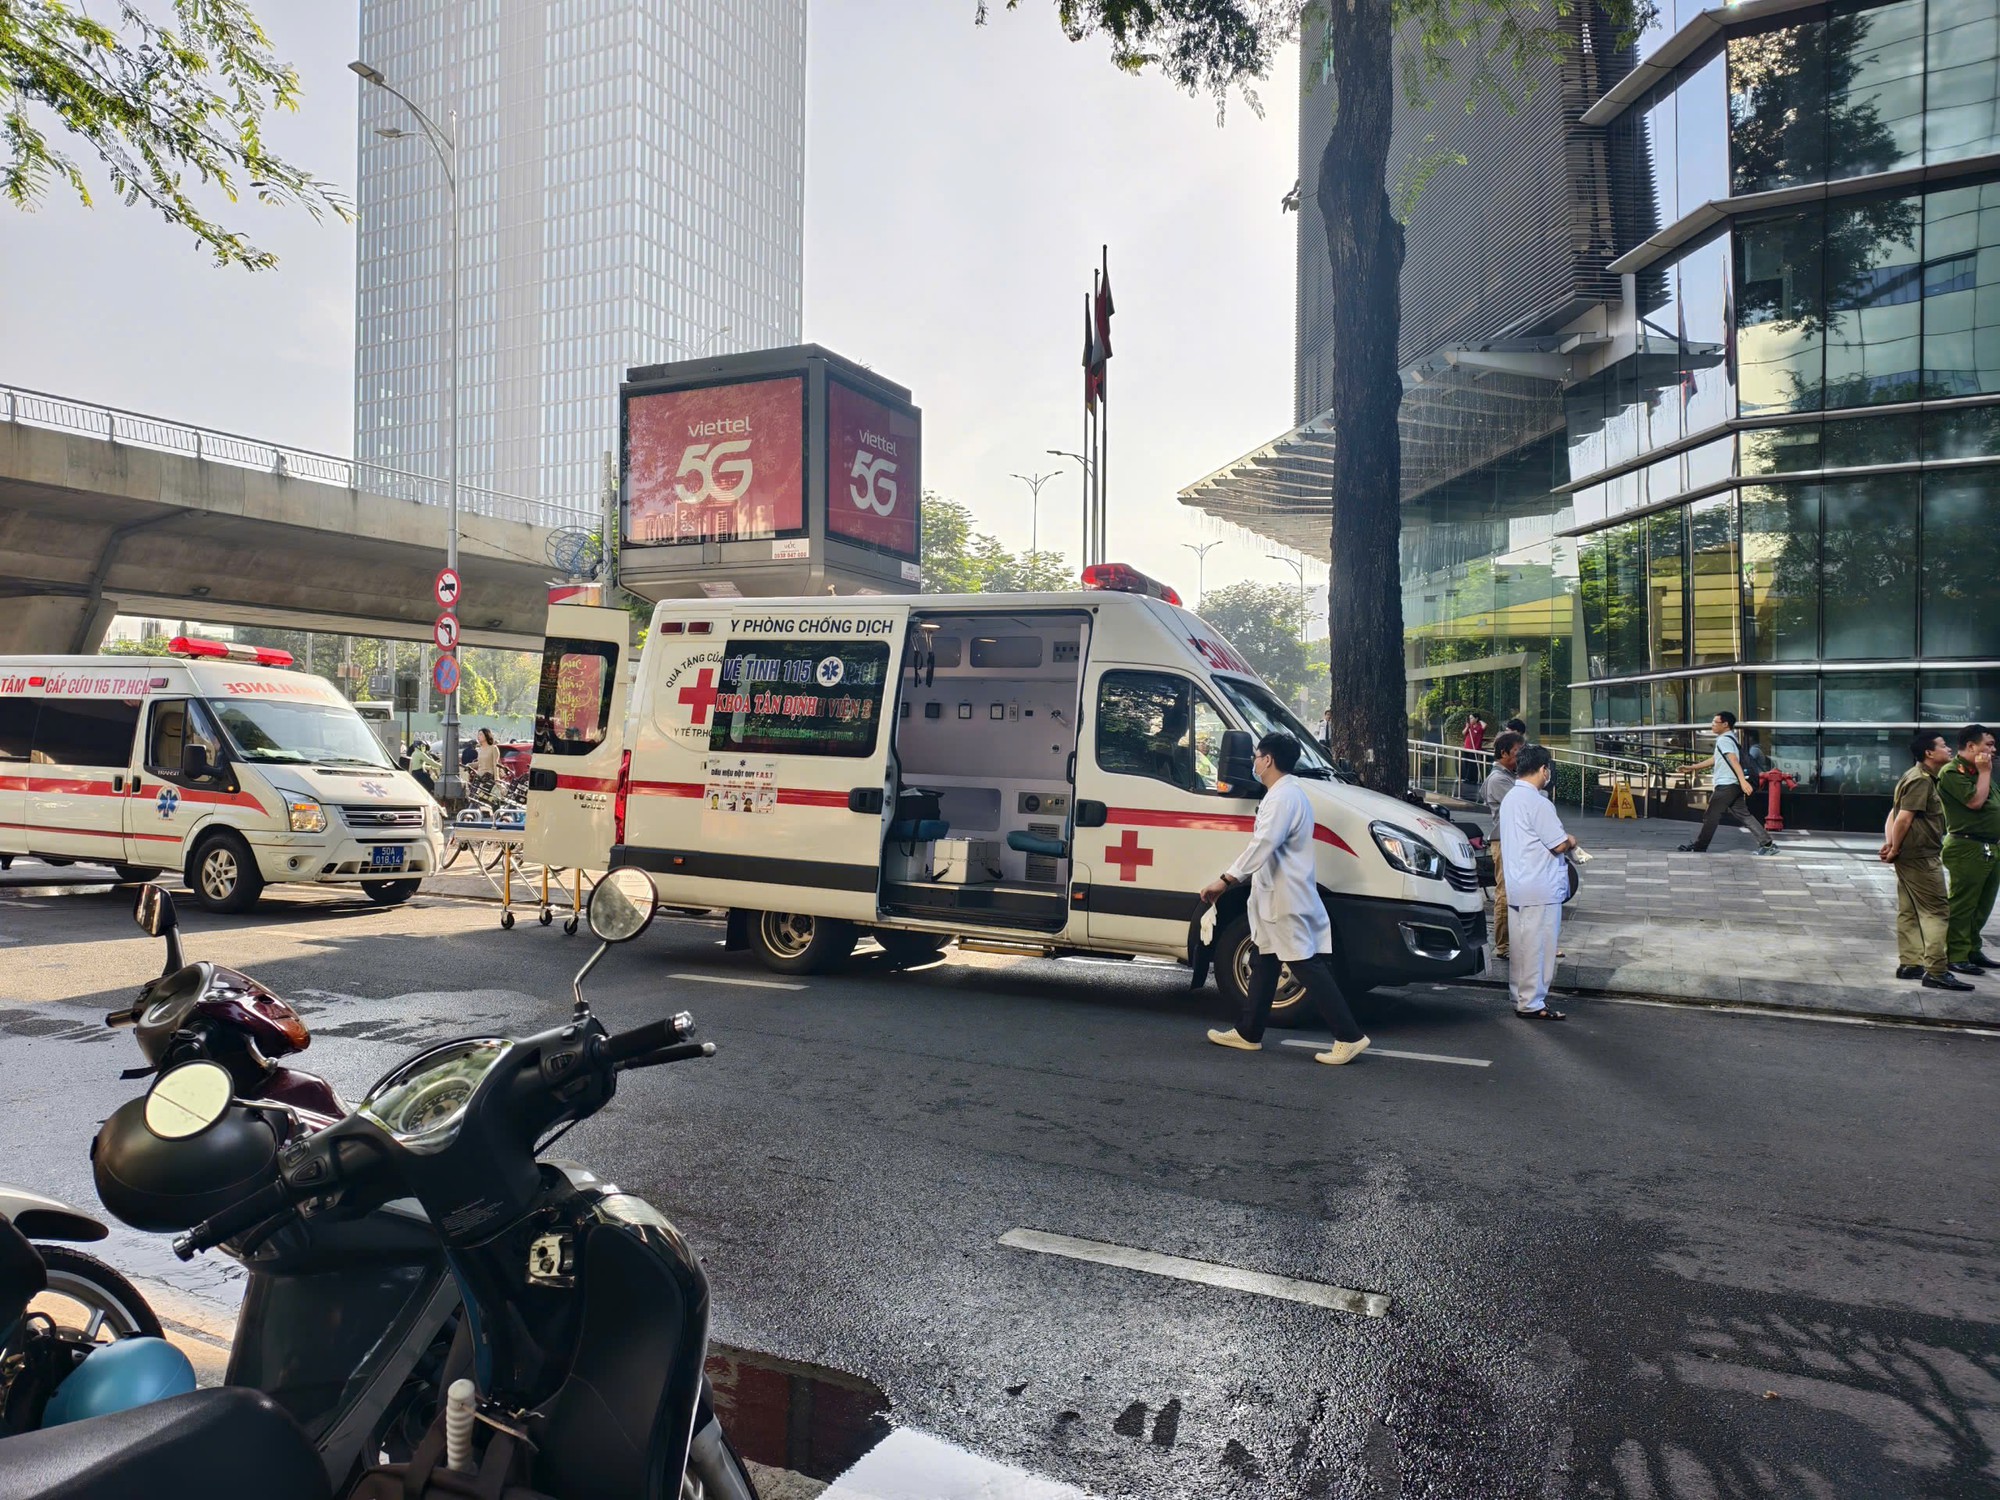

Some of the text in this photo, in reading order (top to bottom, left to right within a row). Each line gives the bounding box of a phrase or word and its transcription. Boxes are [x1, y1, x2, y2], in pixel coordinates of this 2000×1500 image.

[688, 416, 752, 437] viettel
[858, 429, 898, 457] viettel
[675, 440, 753, 504] 5G
[850, 449, 897, 517] 5G
[731, 616, 893, 636] Y PHÒNG CHỐNG DỊCH
[666, 668, 682, 688] QUÀ
[681, 654, 705, 669] TẶNG
[723, 654, 812, 685] VỆ TINH 115
[0, 672, 151, 695] TÂM CẤP CỨU 115 TP.HCM
[715, 690, 818, 720] KHOA TÂN ĐỊNH
[674, 728, 679, 736] Y
[681, 726, 691, 737] TẾ
[376, 856, 400, 864] 018.14
[382, 847, 395, 855] 50A
